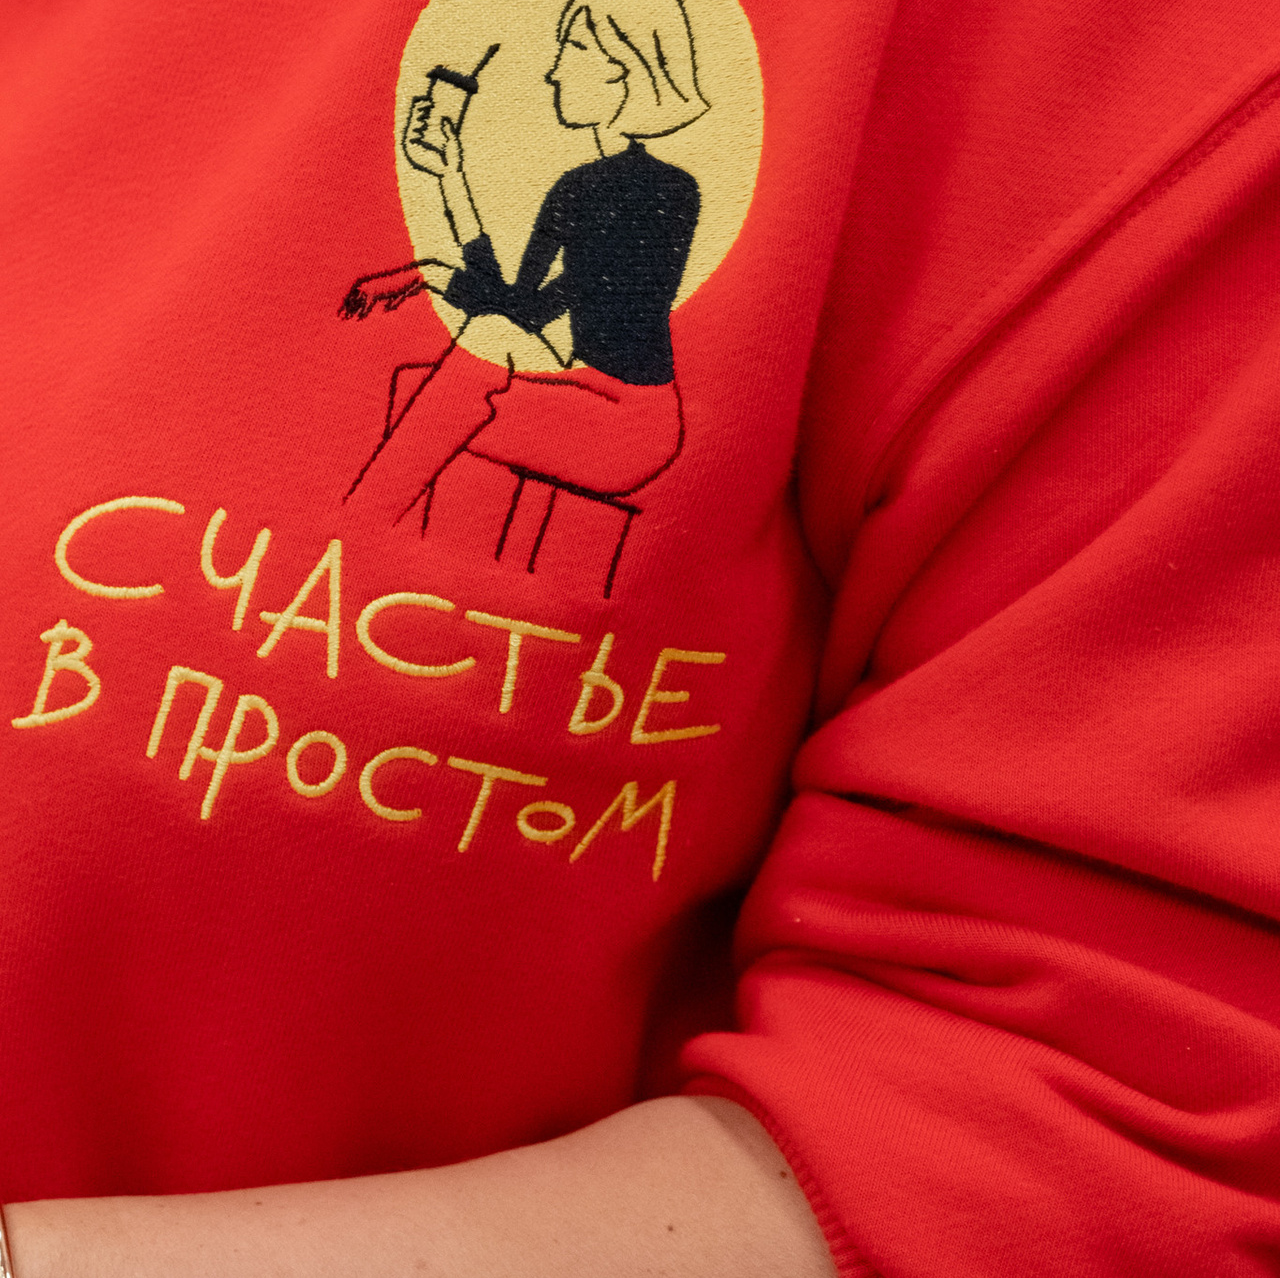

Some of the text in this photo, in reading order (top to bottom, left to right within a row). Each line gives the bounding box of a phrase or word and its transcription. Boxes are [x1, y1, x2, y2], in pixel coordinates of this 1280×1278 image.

[54, 495, 727, 745] СЧАСТЬЕ
[11, 618, 677, 883] В ПРОСТОМ
